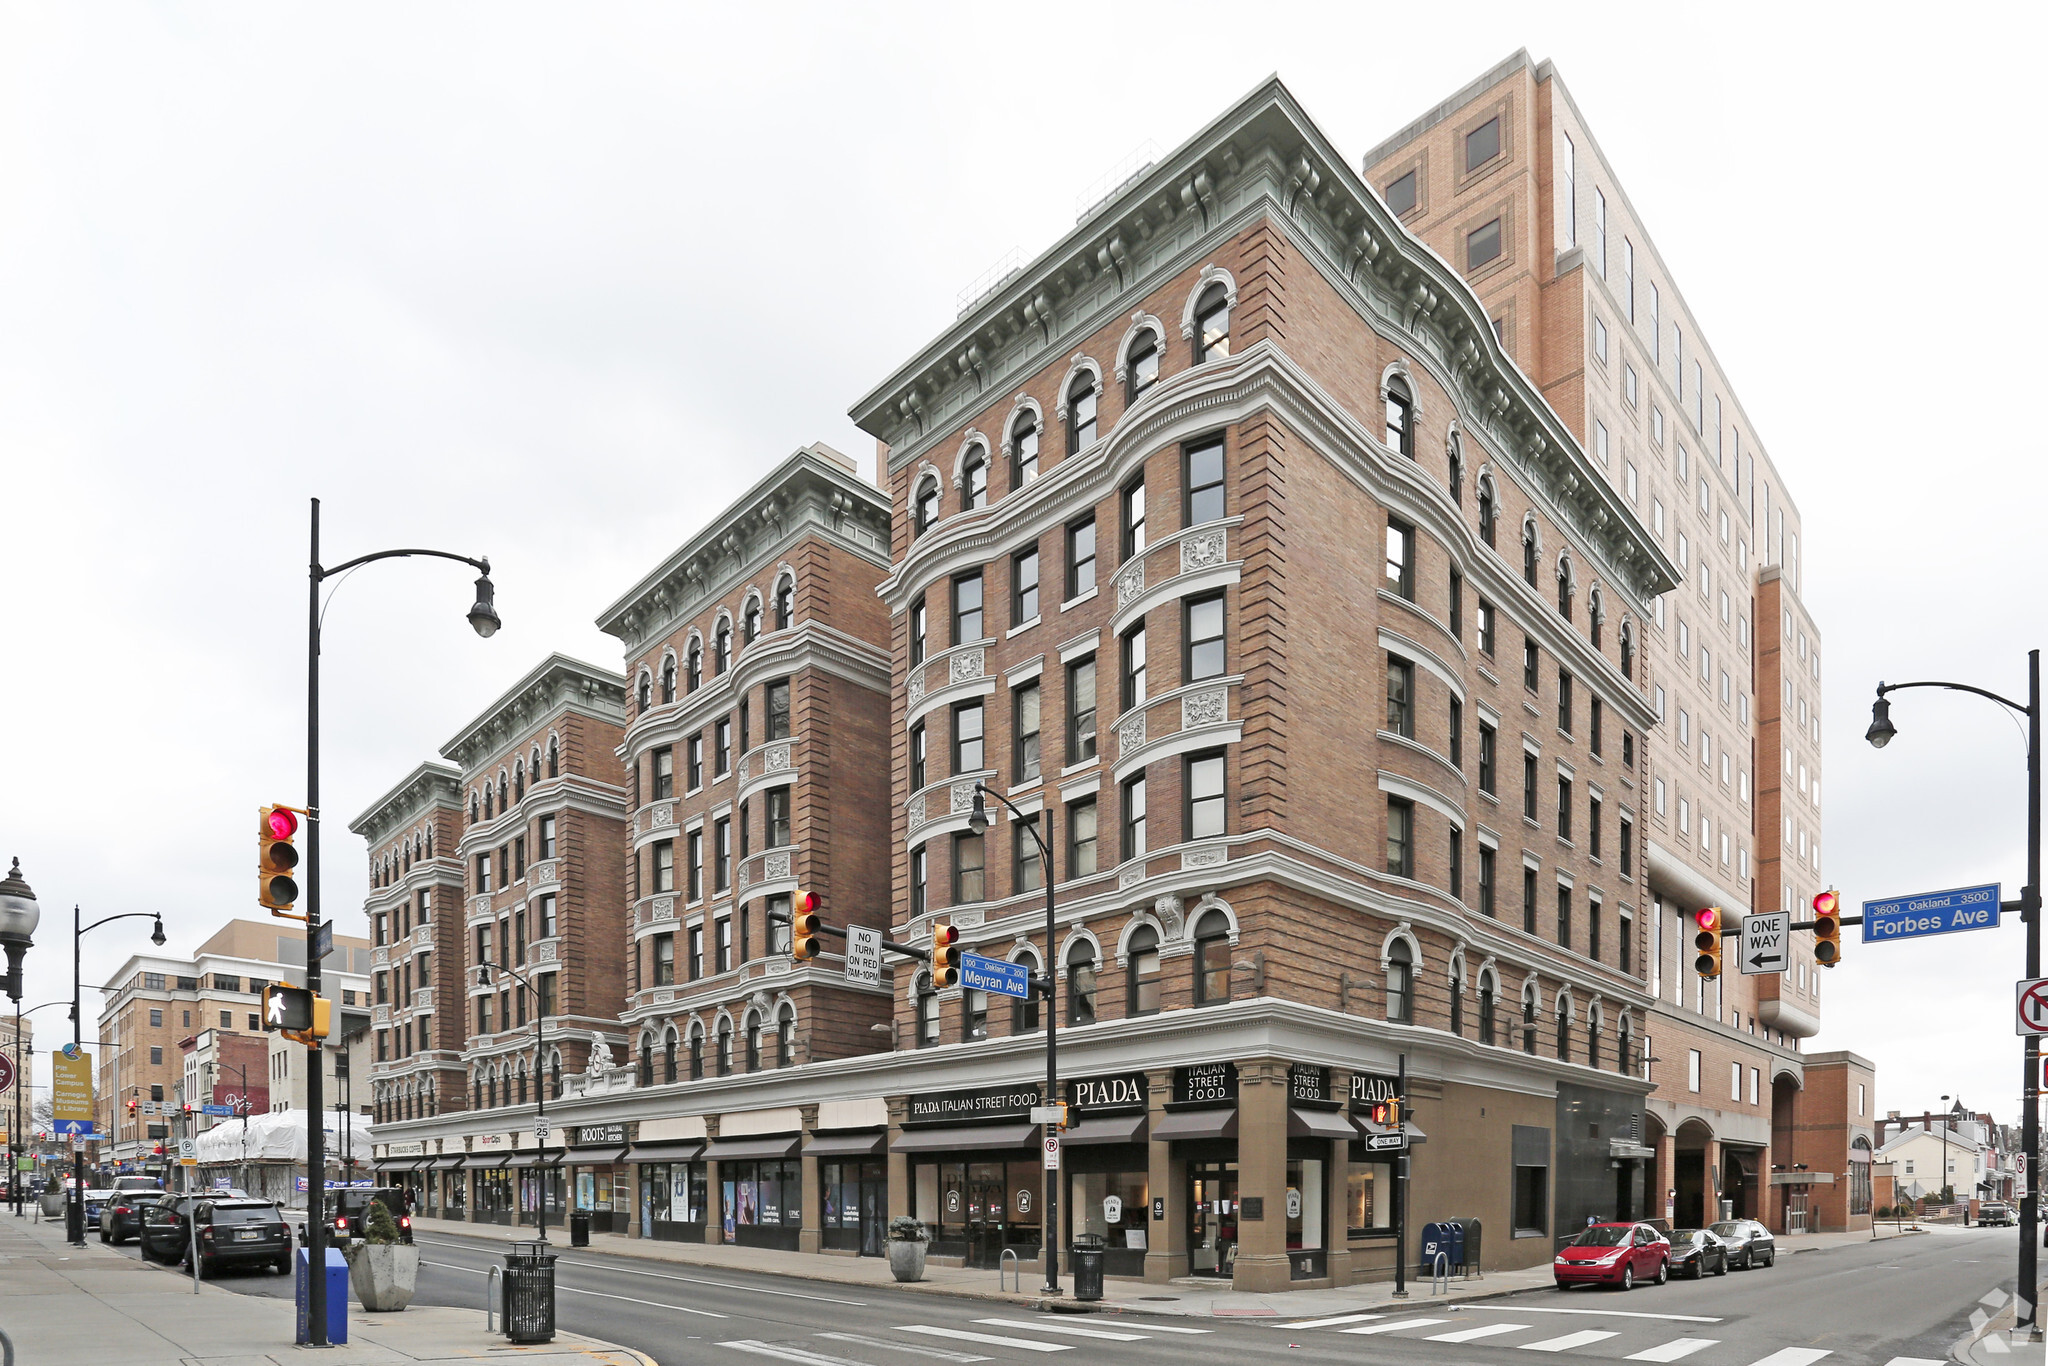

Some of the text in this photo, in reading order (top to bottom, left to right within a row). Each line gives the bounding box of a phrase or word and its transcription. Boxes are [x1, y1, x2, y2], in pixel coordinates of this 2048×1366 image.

[1873, 892, 1989, 916] 3600 Oakland 3500
[1751, 918, 1780, 934] ONE
[1872, 909, 1989, 937] Forbes Ave
[858, 932, 871, 943] NO
[1750, 934, 1780, 949] WAY
[854, 943, 875, 956] TURN
[849, 955, 878, 969] ON RED
[965, 959, 1024, 978] 100 Oakland 200
[847, 967, 878, 980] 7AM-10PM
[965, 969, 1024, 993] Meyran Ave
[1188, 1063, 1226, 1077] ITALIAN
[1293, 1063, 1320, 1076] ITALIAN
[55, 1079, 84, 1087] Campus
[1188, 1075, 1225, 1088] STREET
[1294, 1075, 1320, 1088] STREET
[1351, 1075, 1396, 1101] PIADA
[55, 1091, 87, 1099] Carnegie
[1075, 1078, 1142, 1106] PIADA
[1188, 1087, 1226, 1100] FOOD
[1294, 1087, 1320, 1099] FOOD
[55, 1098, 89, 1106] Museums
[914, 1093, 1037, 1114] PIADA ITALIAN STREET FOOD
[63, 1105, 88, 1113] Library
[536, 1127, 548, 1137] 25
[581, 1127, 605, 1142] ROOTS
[607, 1124, 623, 1132] NATURAL
[607, 1133, 623, 1141] KITCHEN
[1376, 1137, 1400, 1146] ONE WAY
[390, 1145, 409, 1154] STARBUCKS
